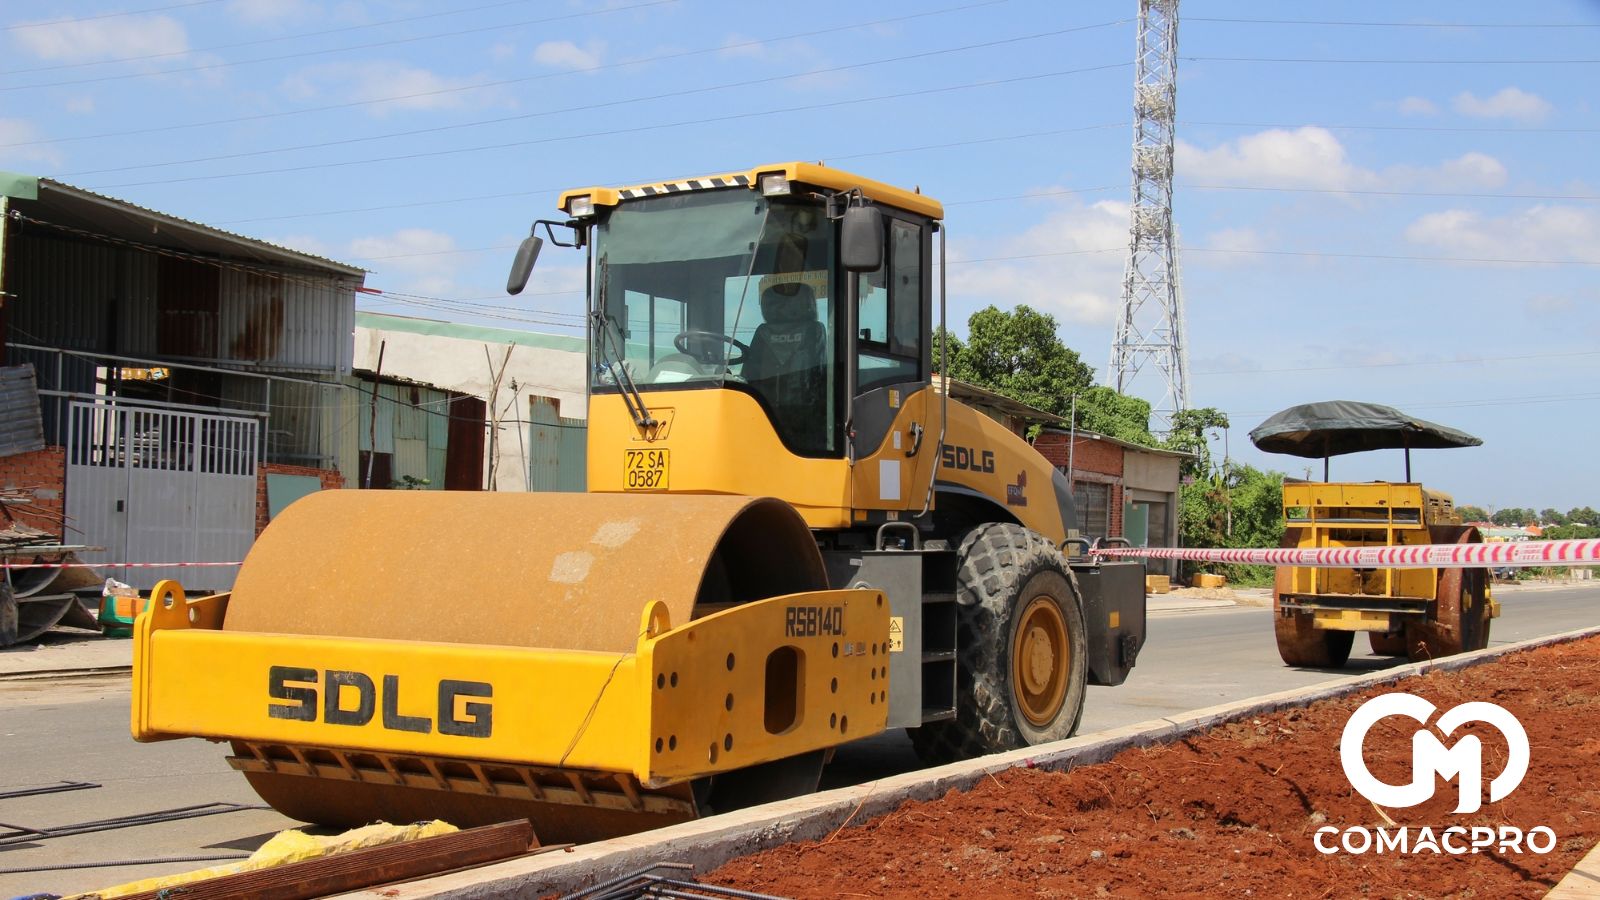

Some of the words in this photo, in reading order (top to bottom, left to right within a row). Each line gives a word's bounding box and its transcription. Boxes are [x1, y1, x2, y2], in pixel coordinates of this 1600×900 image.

[627, 451, 644, 469] 72
[648, 451, 665, 469] SA
[942, 444, 995, 474] SDLG
[628, 470, 663, 487] 0587
[268, 665, 494, 738] SDLG
